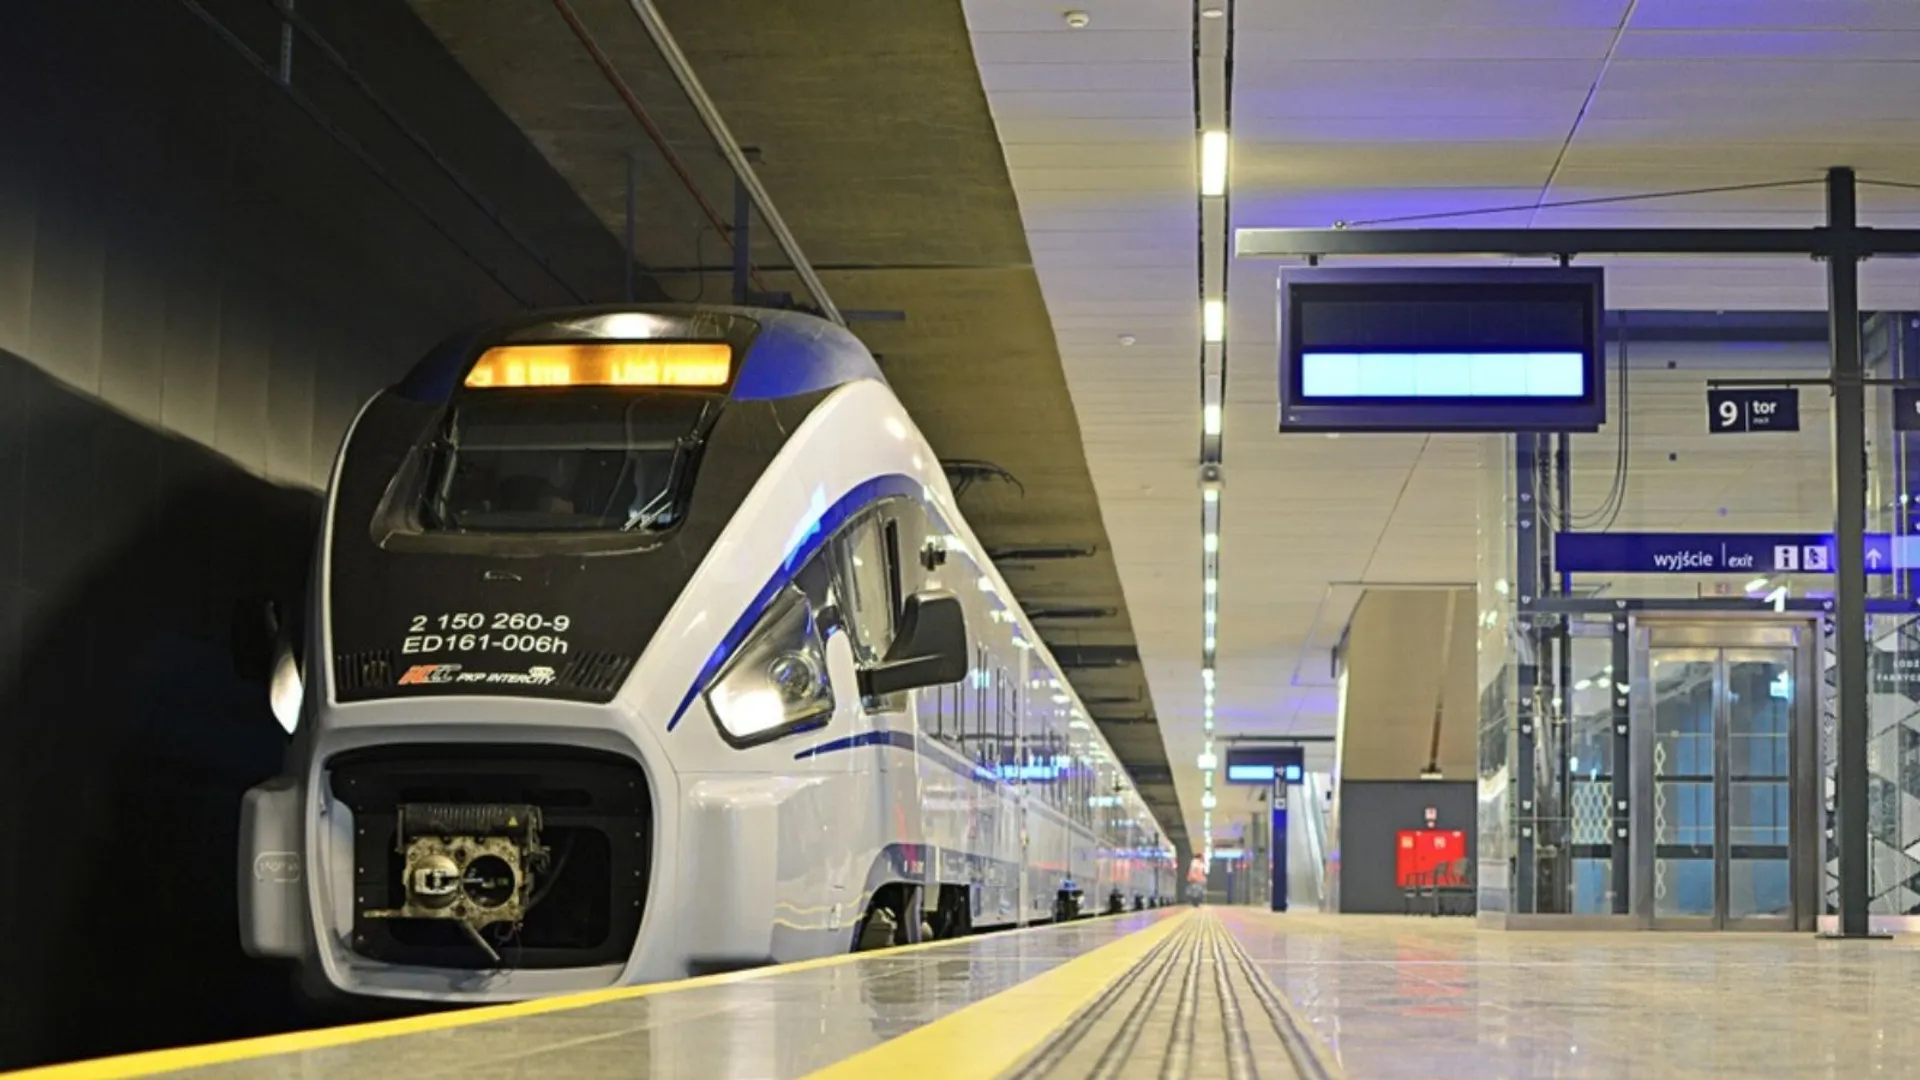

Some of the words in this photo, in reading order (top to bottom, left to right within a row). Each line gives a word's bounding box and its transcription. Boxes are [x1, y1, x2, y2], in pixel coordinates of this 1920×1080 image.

[1719, 401, 1738, 427] 9
[1752, 400, 1776, 414] tor
[1654, 551, 1713, 570] wyjście
[1728, 554, 1753, 568] exit
[409, 615, 428, 632] 2
[438, 612, 485, 630] 150
[491, 612, 570, 632] 260-9
[402, 634, 568, 654] ED161-006h
[456, 672, 486, 683] PKP
[486, 672, 556, 685] INTERCITY
